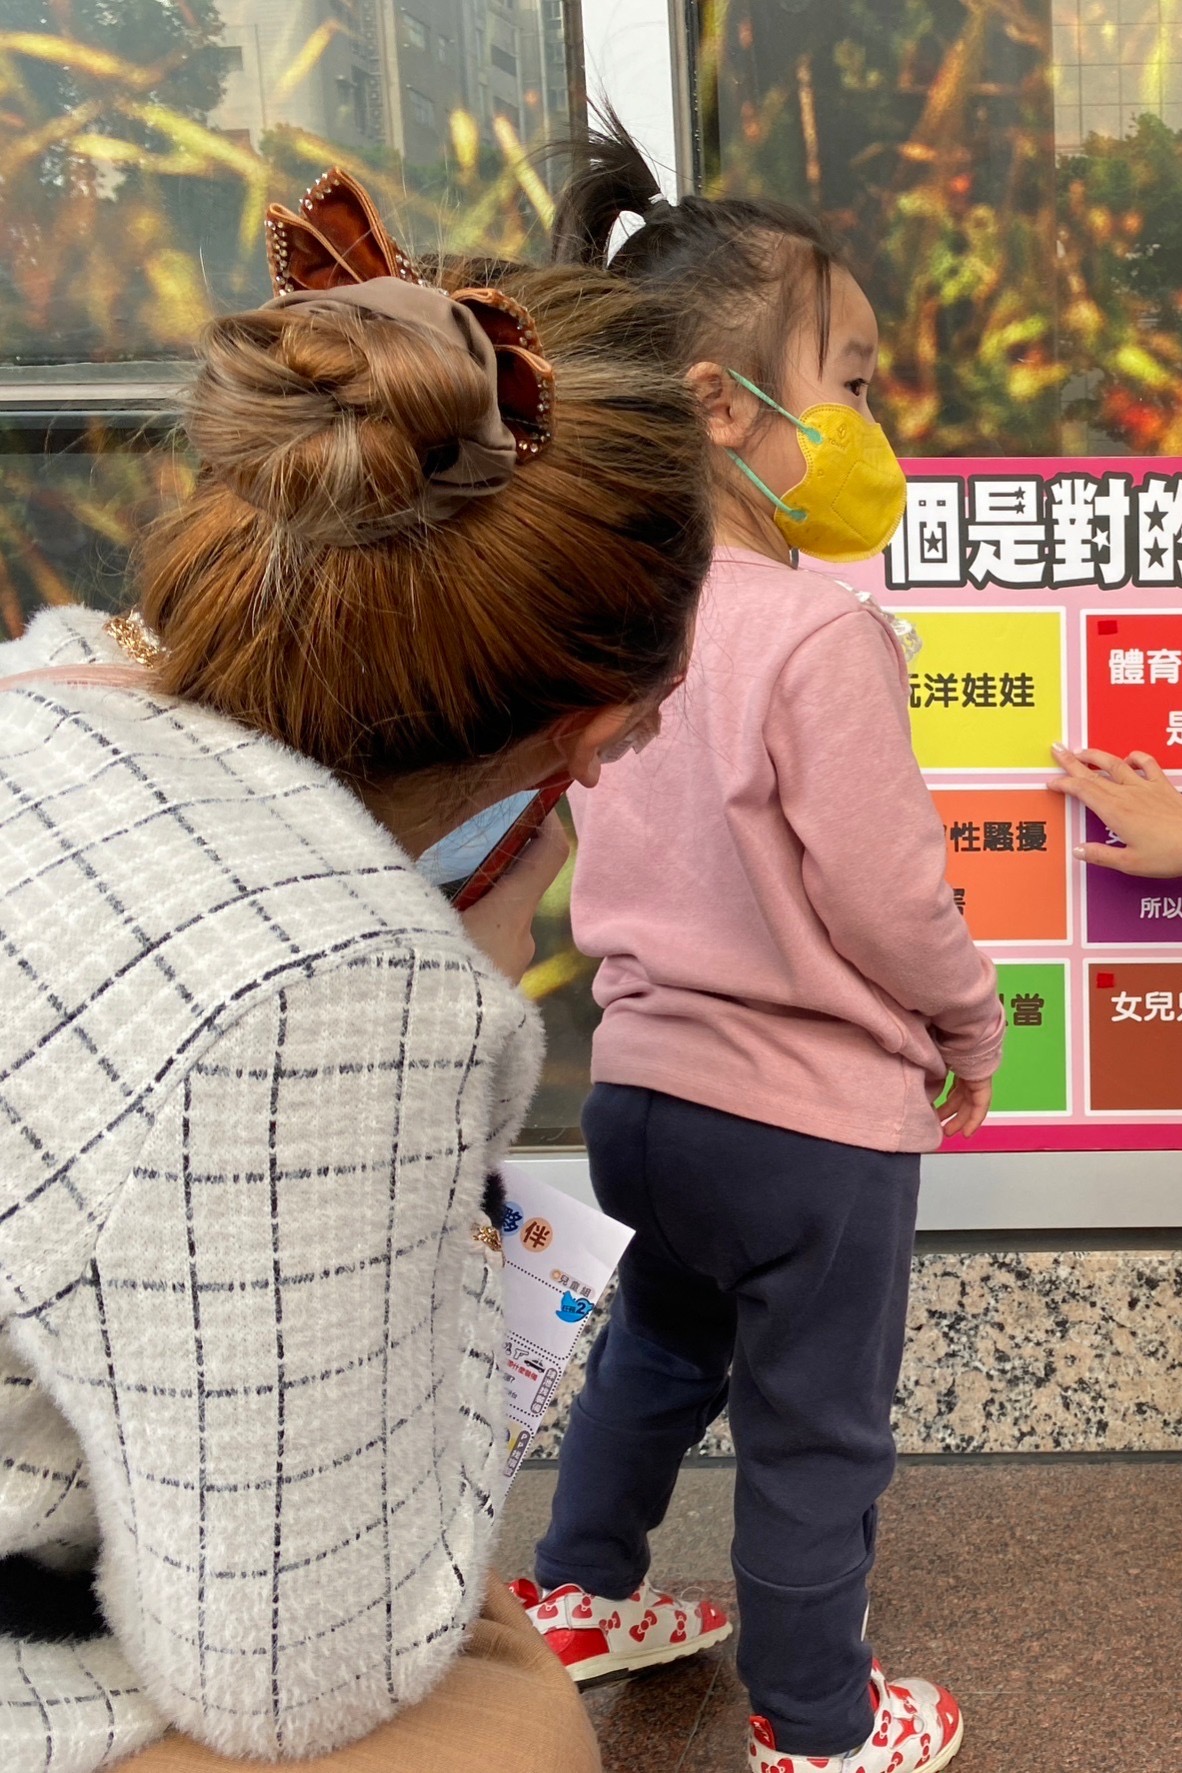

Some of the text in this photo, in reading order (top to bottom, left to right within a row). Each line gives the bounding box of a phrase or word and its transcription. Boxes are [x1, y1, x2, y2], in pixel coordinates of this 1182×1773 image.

[944, 821, 1048, 853] 性騷擾
[999, 993, 1045, 1028] 當
[558, 1273, 592, 1298] 兒童組
